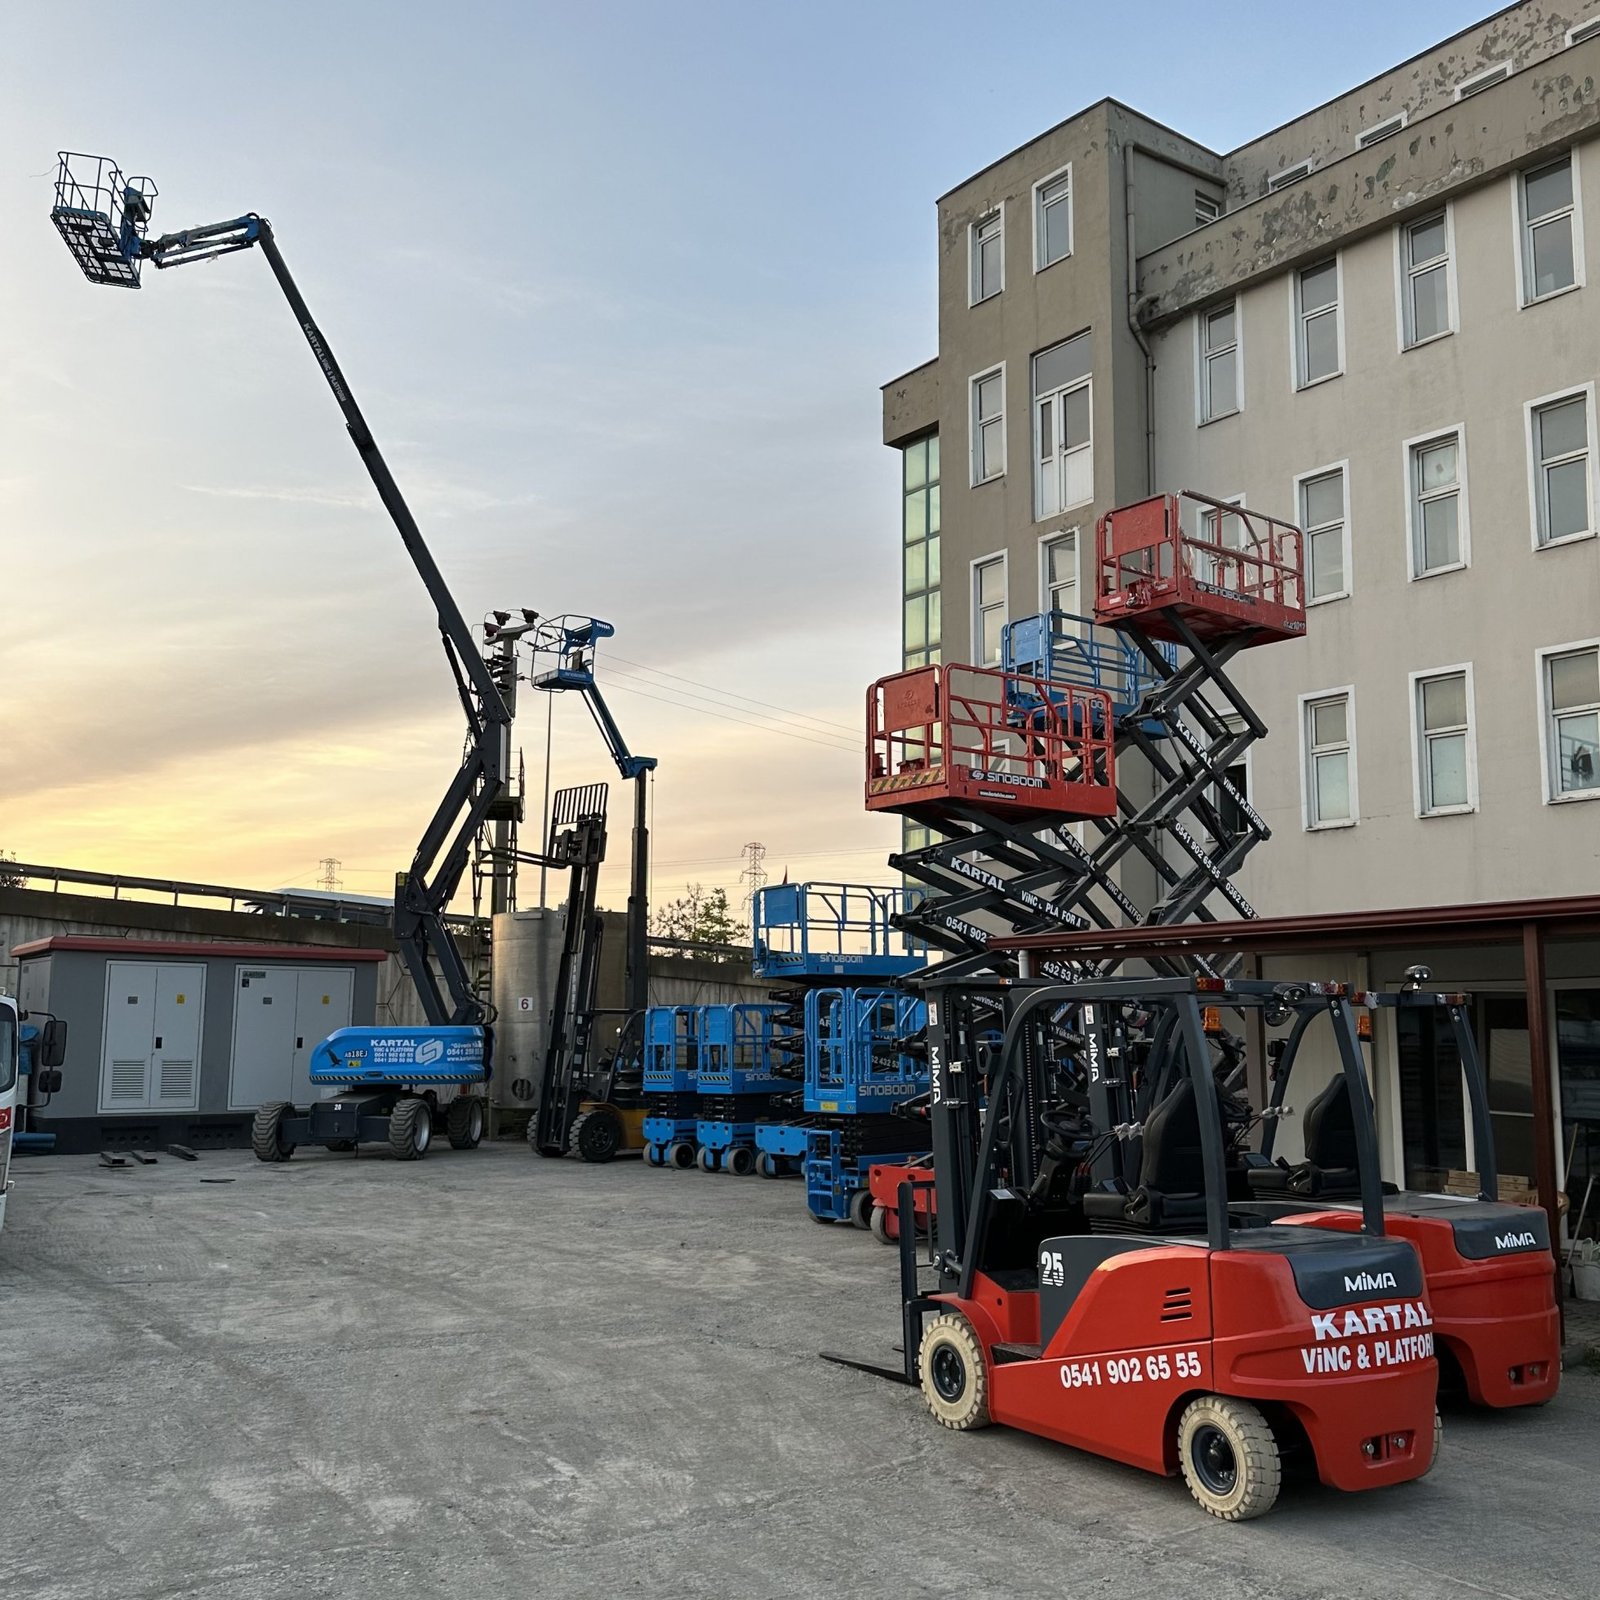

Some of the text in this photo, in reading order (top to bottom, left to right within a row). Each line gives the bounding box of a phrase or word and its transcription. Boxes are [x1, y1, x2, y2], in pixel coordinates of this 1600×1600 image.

[303, 322, 325, 360] KARTAL
[987, 772, 1043, 789] SINOBOOM
[1175, 719, 1213, 770] KARTAL
[1234, 793, 1240, 801] &
[1238, 798, 1265, 833] PLATFORM
[1059, 825, 1096, 871] KARTAL
[950, 857, 1006, 892] KARTAL
[1175, 822, 1191, 844] 0541
[1190, 840, 1203, 860] 902
[1202, 855, 1212, 870] 65
[1210, 865, 1221, 879] 55
[1225, 882, 1241, 904] 0362
[1240, 901, 1254, 917] 432
[946, 916, 987, 943] 0541 902
[820, 954, 864, 963] SINOBOOM
[1043, 961, 1060, 976] 432
[1060, 968, 1071, 981] 53
[1085, 960, 1095, 970] 65
[521, 998, 529, 1010] 6
[370, 1039, 418, 1047] KARTAL
[879, 1057, 891, 1066] 432
[859, 1084, 916, 1096] SINOBOOM
[1040, 1251, 1065, 1287] 25
[1311, 1301, 1433, 1341] KARTAL
[1060, 1351, 1202, 1389] 0541 902 65 55
[1356, 1343, 1372, 1370] &
